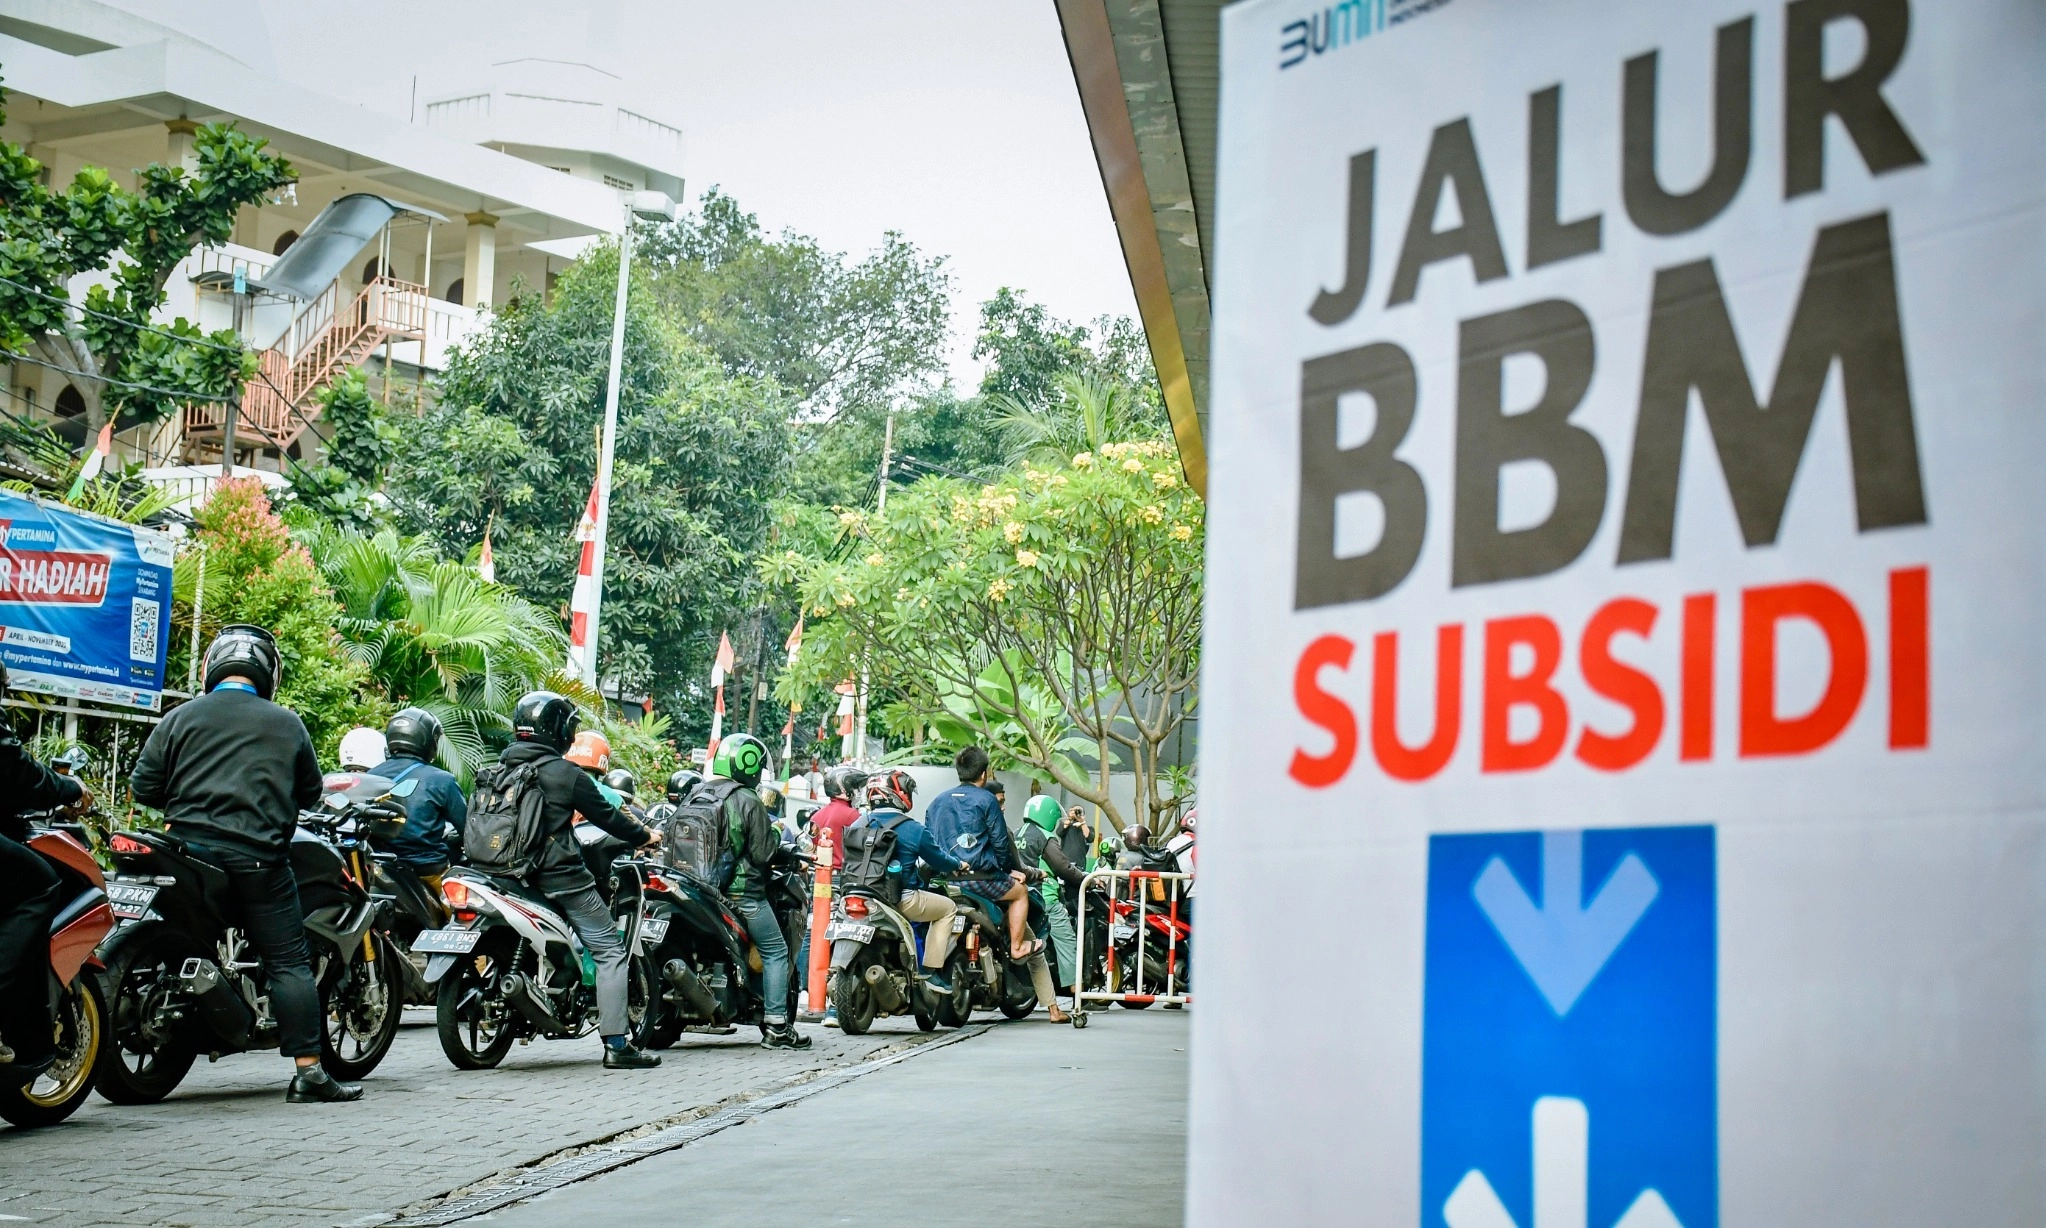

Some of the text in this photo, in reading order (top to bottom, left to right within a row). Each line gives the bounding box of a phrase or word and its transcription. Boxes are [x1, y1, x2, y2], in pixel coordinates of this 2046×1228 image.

[1306, 0, 1929, 327] JALUR
[1292, 209, 1931, 613] BBM
[18, 559, 106, 596] HADIAH
[8, 631, 24, 641] APRIL
[27, 635, 54, 646] NOVEMBER
[3, 649, 52, 667] @mypertamina
[62, 660, 120, 678] www.mypertamina.id
[1287, 564, 1931, 789] SUBSIDI
[124, 888, 152, 902] PKM
